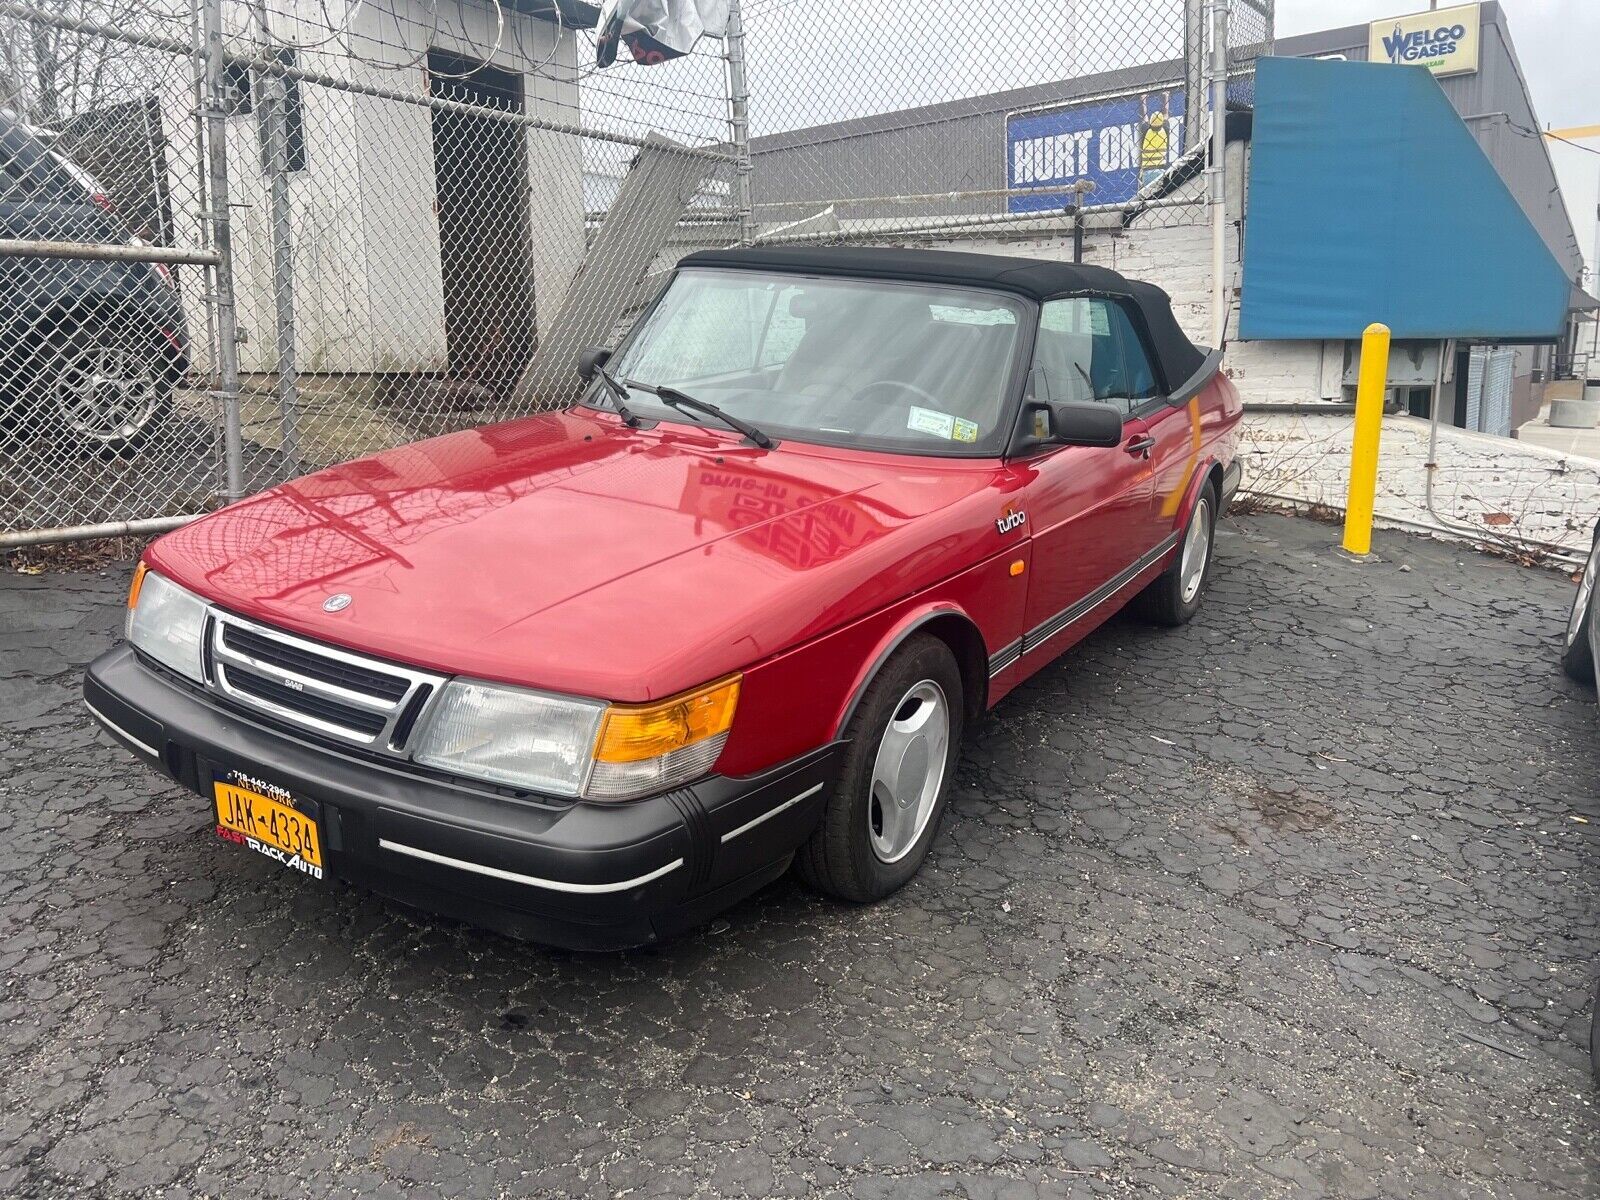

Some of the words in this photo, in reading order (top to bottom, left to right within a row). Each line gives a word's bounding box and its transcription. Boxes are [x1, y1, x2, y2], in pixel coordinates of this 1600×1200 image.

[1382, 24, 1465, 59] WELCO
[1402, 41, 1457, 60] GASES
[1014, 130, 1093, 185] HURT
[1100, 122, 1140, 173] ON
[996, 509, 1026, 534] turbo
[286, 853, 322, 880] AUTO
